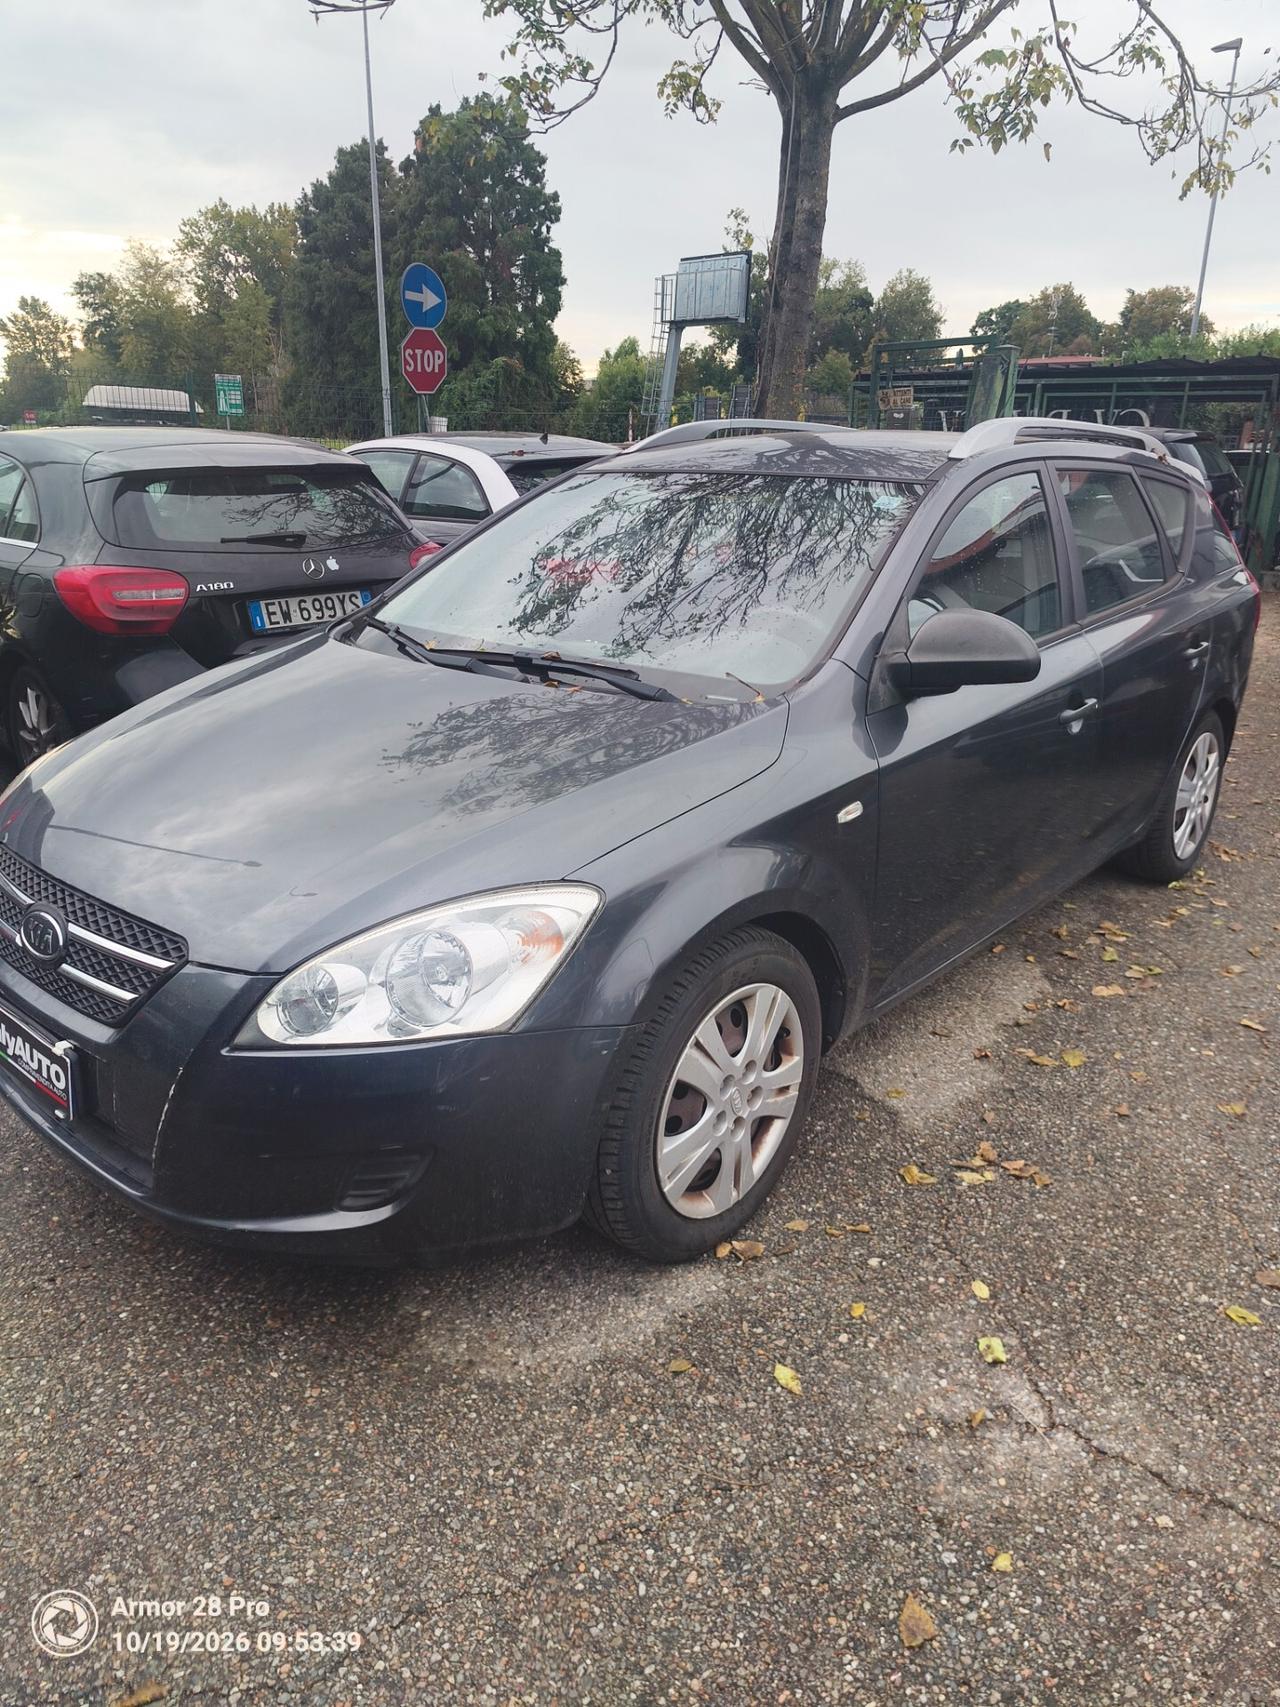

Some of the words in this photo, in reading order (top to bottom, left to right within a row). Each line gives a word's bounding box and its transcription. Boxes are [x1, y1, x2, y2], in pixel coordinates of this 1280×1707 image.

[405, 349, 444, 373] STOP
[196, 581, 235, 592] A180
[264, 599, 293, 625] EW
[298, 593, 361, 622] 699YS
